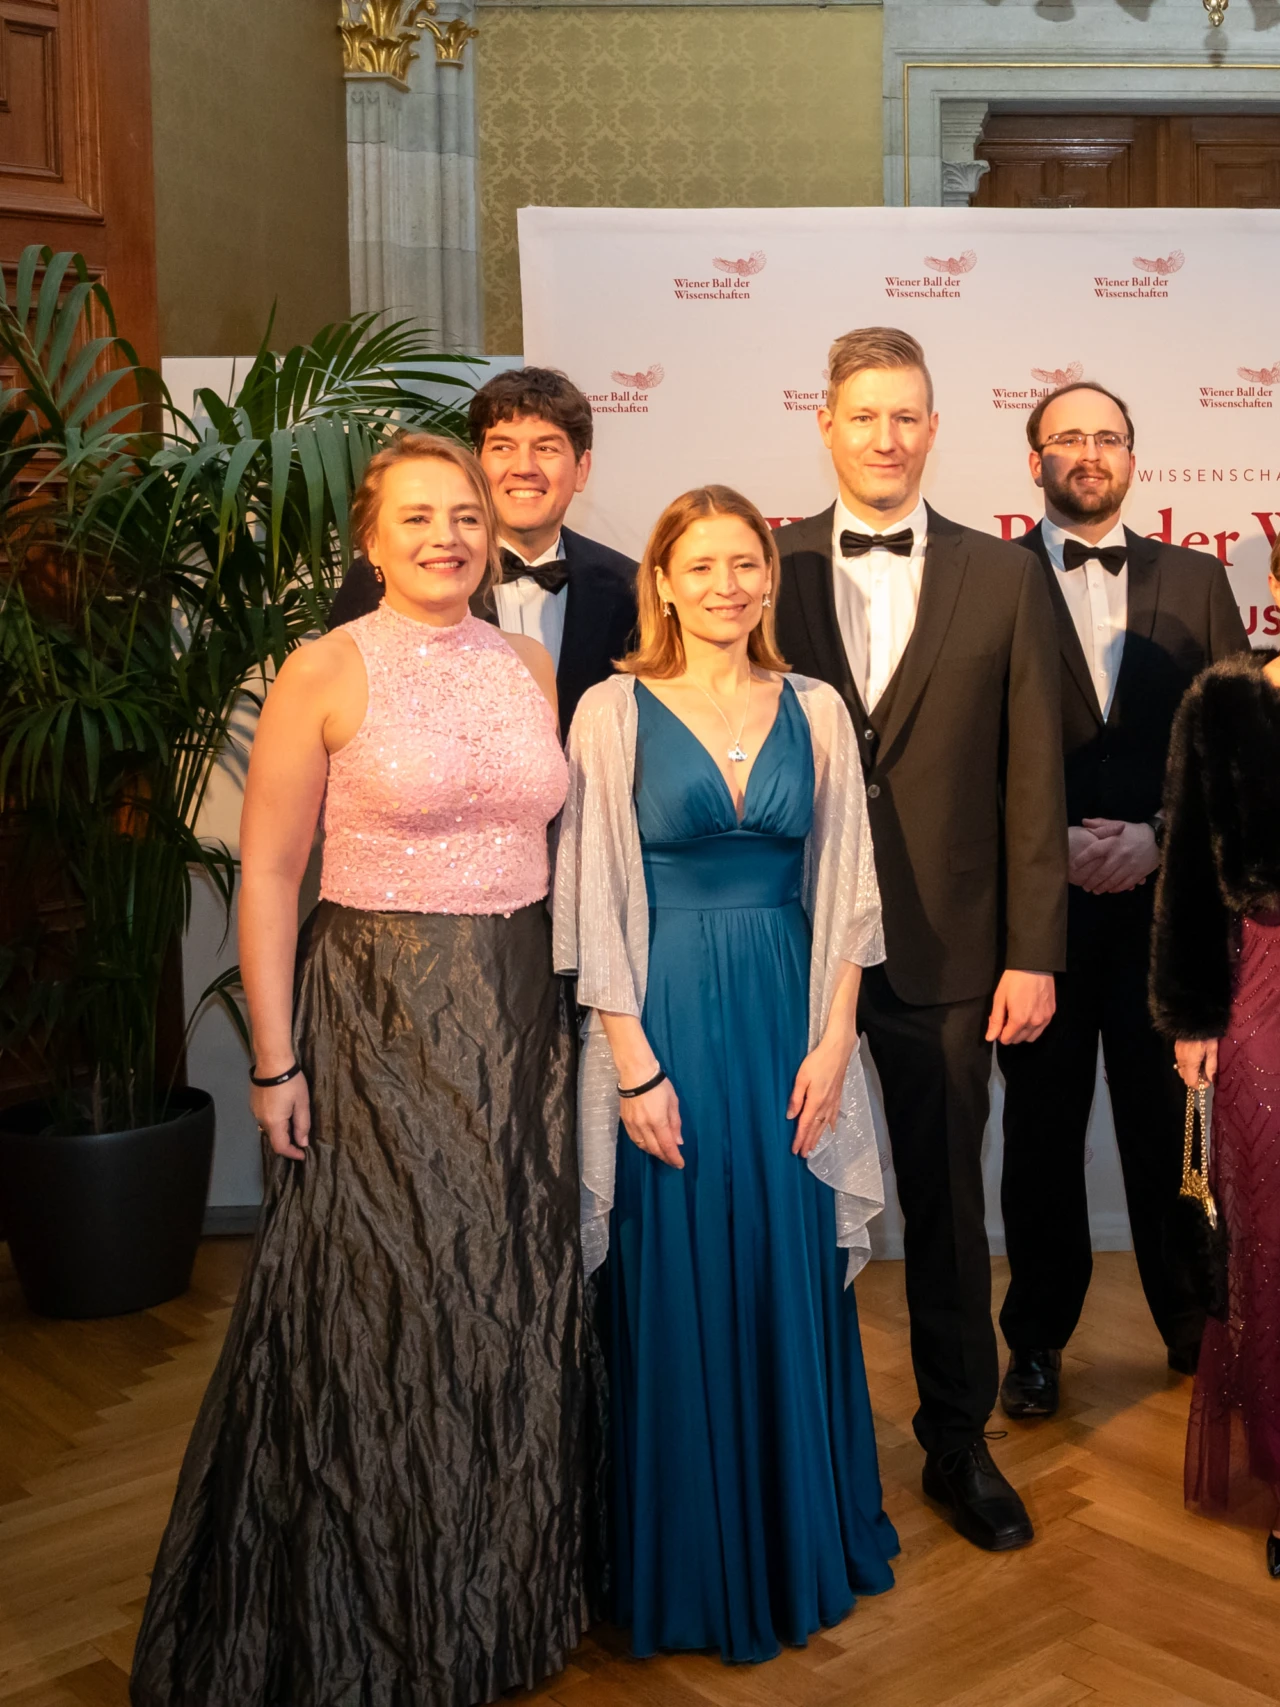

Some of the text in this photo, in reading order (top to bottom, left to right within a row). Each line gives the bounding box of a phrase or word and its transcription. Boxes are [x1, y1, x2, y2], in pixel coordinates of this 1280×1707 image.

[673, 278, 750, 288] Wiener Ball der
[885, 276, 961, 287] Wiener Ball der
[1094, 276, 1169, 287] Wiener Ball der
[674, 289, 750, 300] Wissenschaften
[885, 288, 961, 298] Wissenschaften
[1094, 288, 1169, 298] Wissenschaften
[583, 391, 649, 401] iener Ball der
[783, 390, 819, 399] Wiener
[992, 388, 1049, 398] Wiener Ball
[1199, 387, 1273, 397] Wiener Ball der
[592, 403, 649, 413] senschaften
[1199, 398, 1273, 408] Wissenschaften
